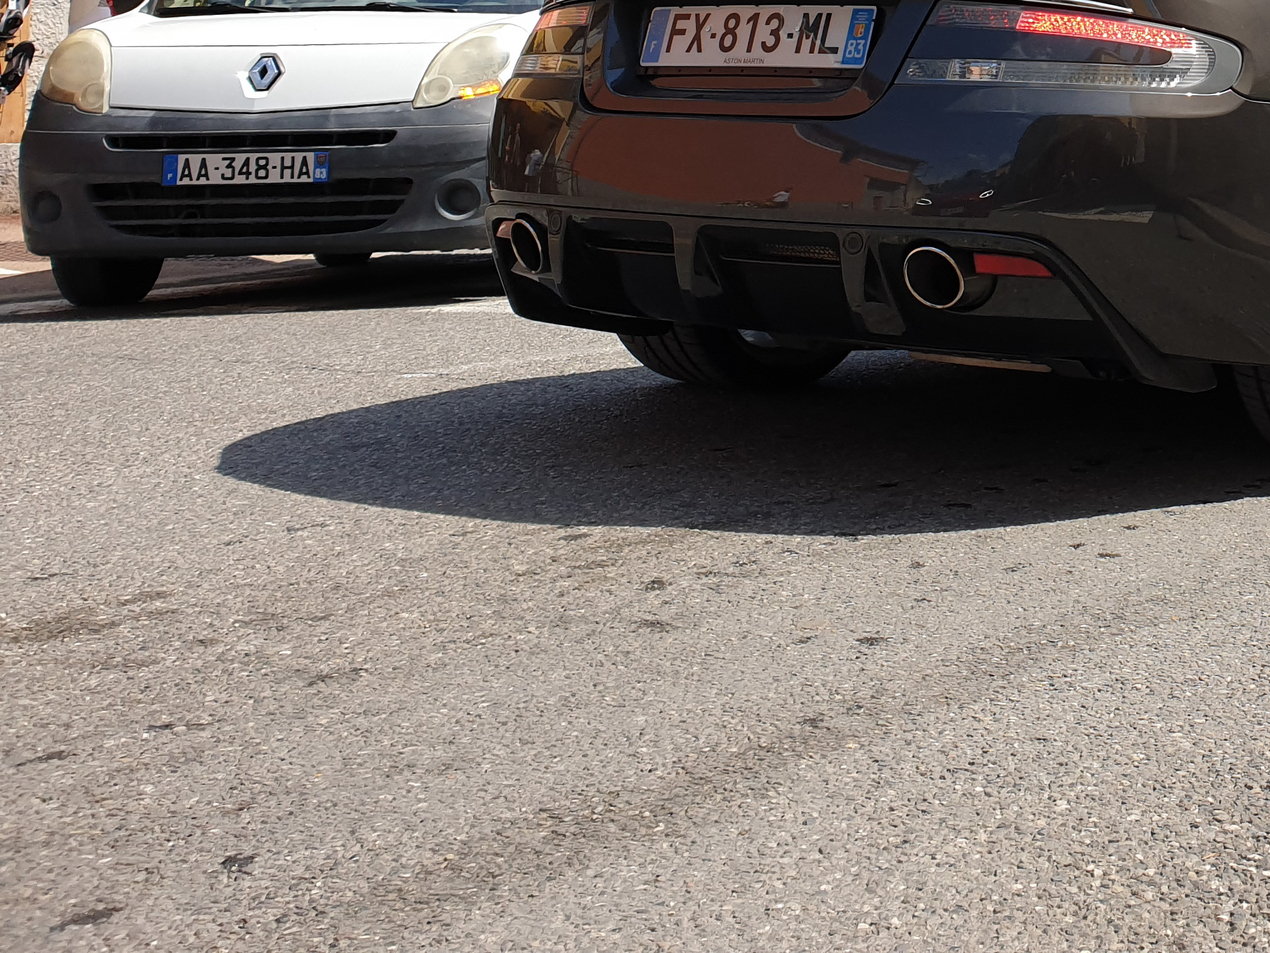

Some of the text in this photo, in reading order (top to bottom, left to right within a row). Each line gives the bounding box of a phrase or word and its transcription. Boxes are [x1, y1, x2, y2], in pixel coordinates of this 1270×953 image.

[665, 12, 840, 55] FX-813-ML
[845, 39, 866, 59] 83
[723, 57, 765, 65] ASTON MARTIN
[179, 155, 311, 182] AA-348-HA
[315, 168, 327, 180] 83
